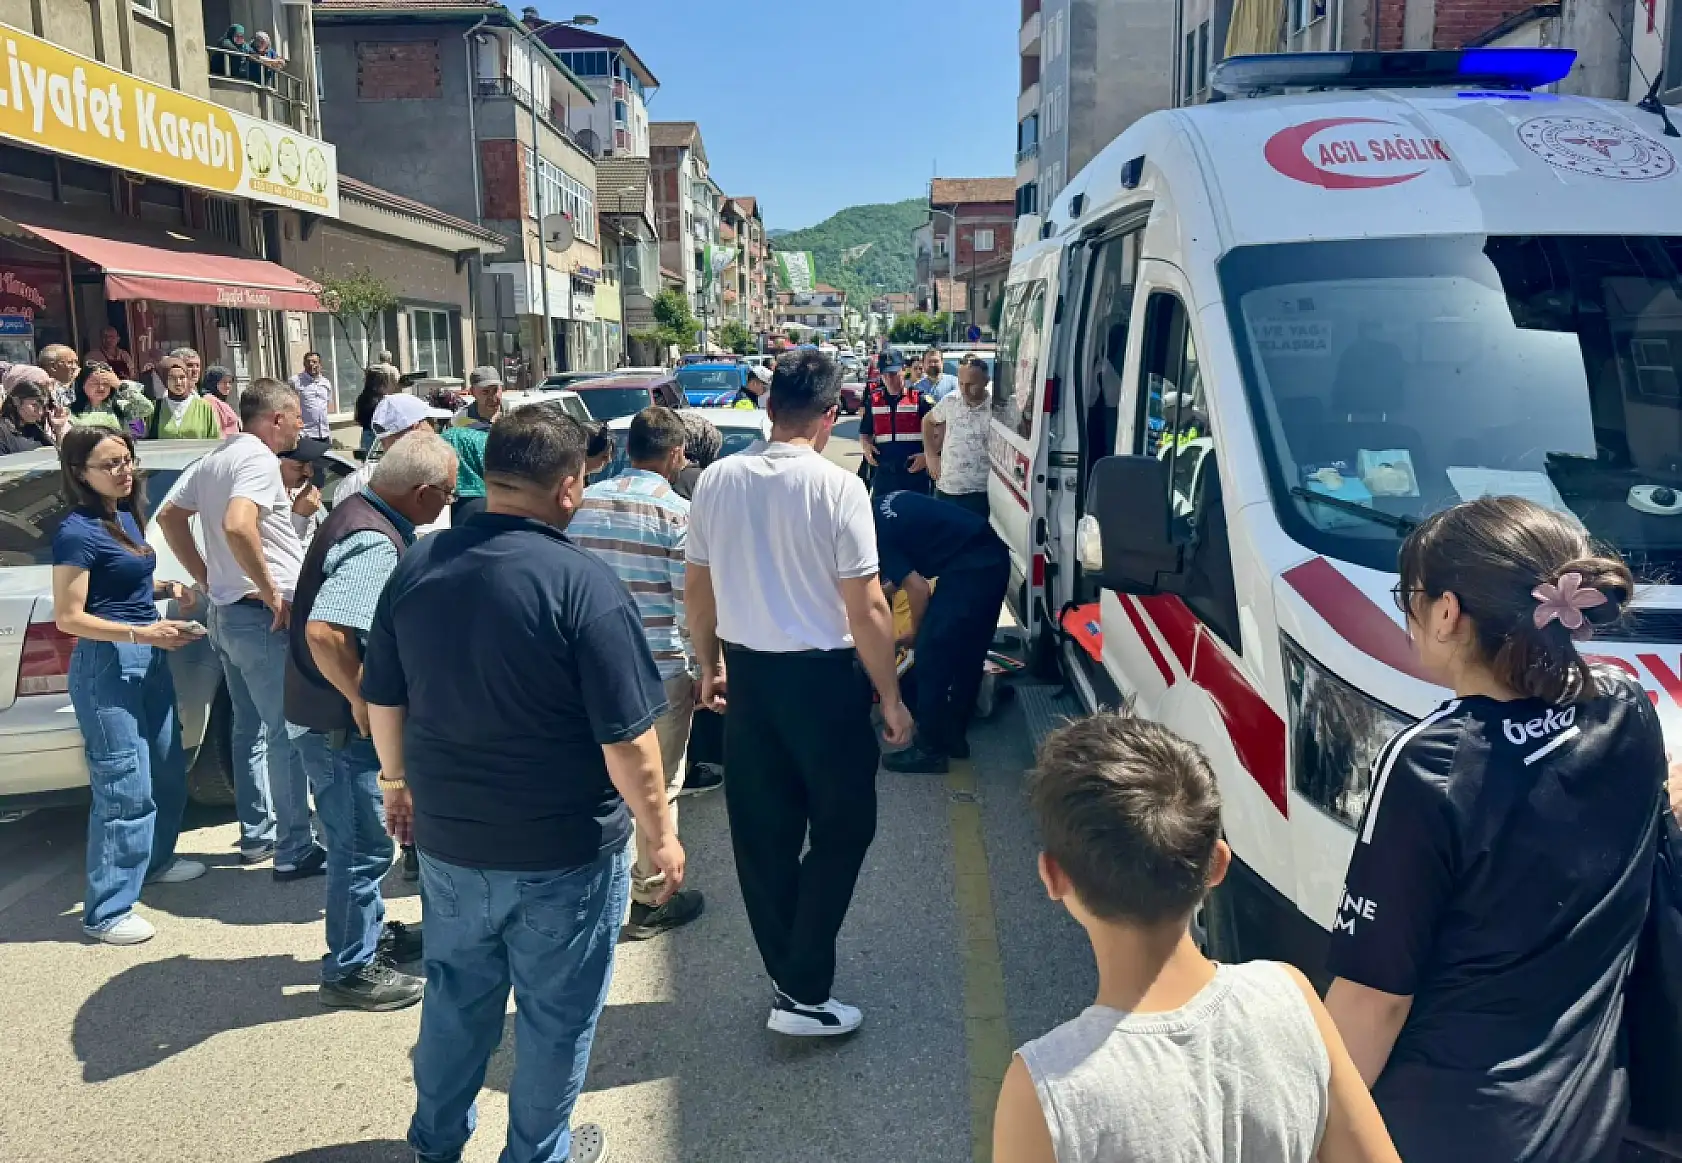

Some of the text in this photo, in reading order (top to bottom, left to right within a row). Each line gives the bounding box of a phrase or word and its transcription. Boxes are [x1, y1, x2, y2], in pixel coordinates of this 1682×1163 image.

[135, 87, 235, 172] Kasabı
[1318, 133, 1451, 166] ACİL SAĞLIK
[1502, 705, 1576, 745] beko
